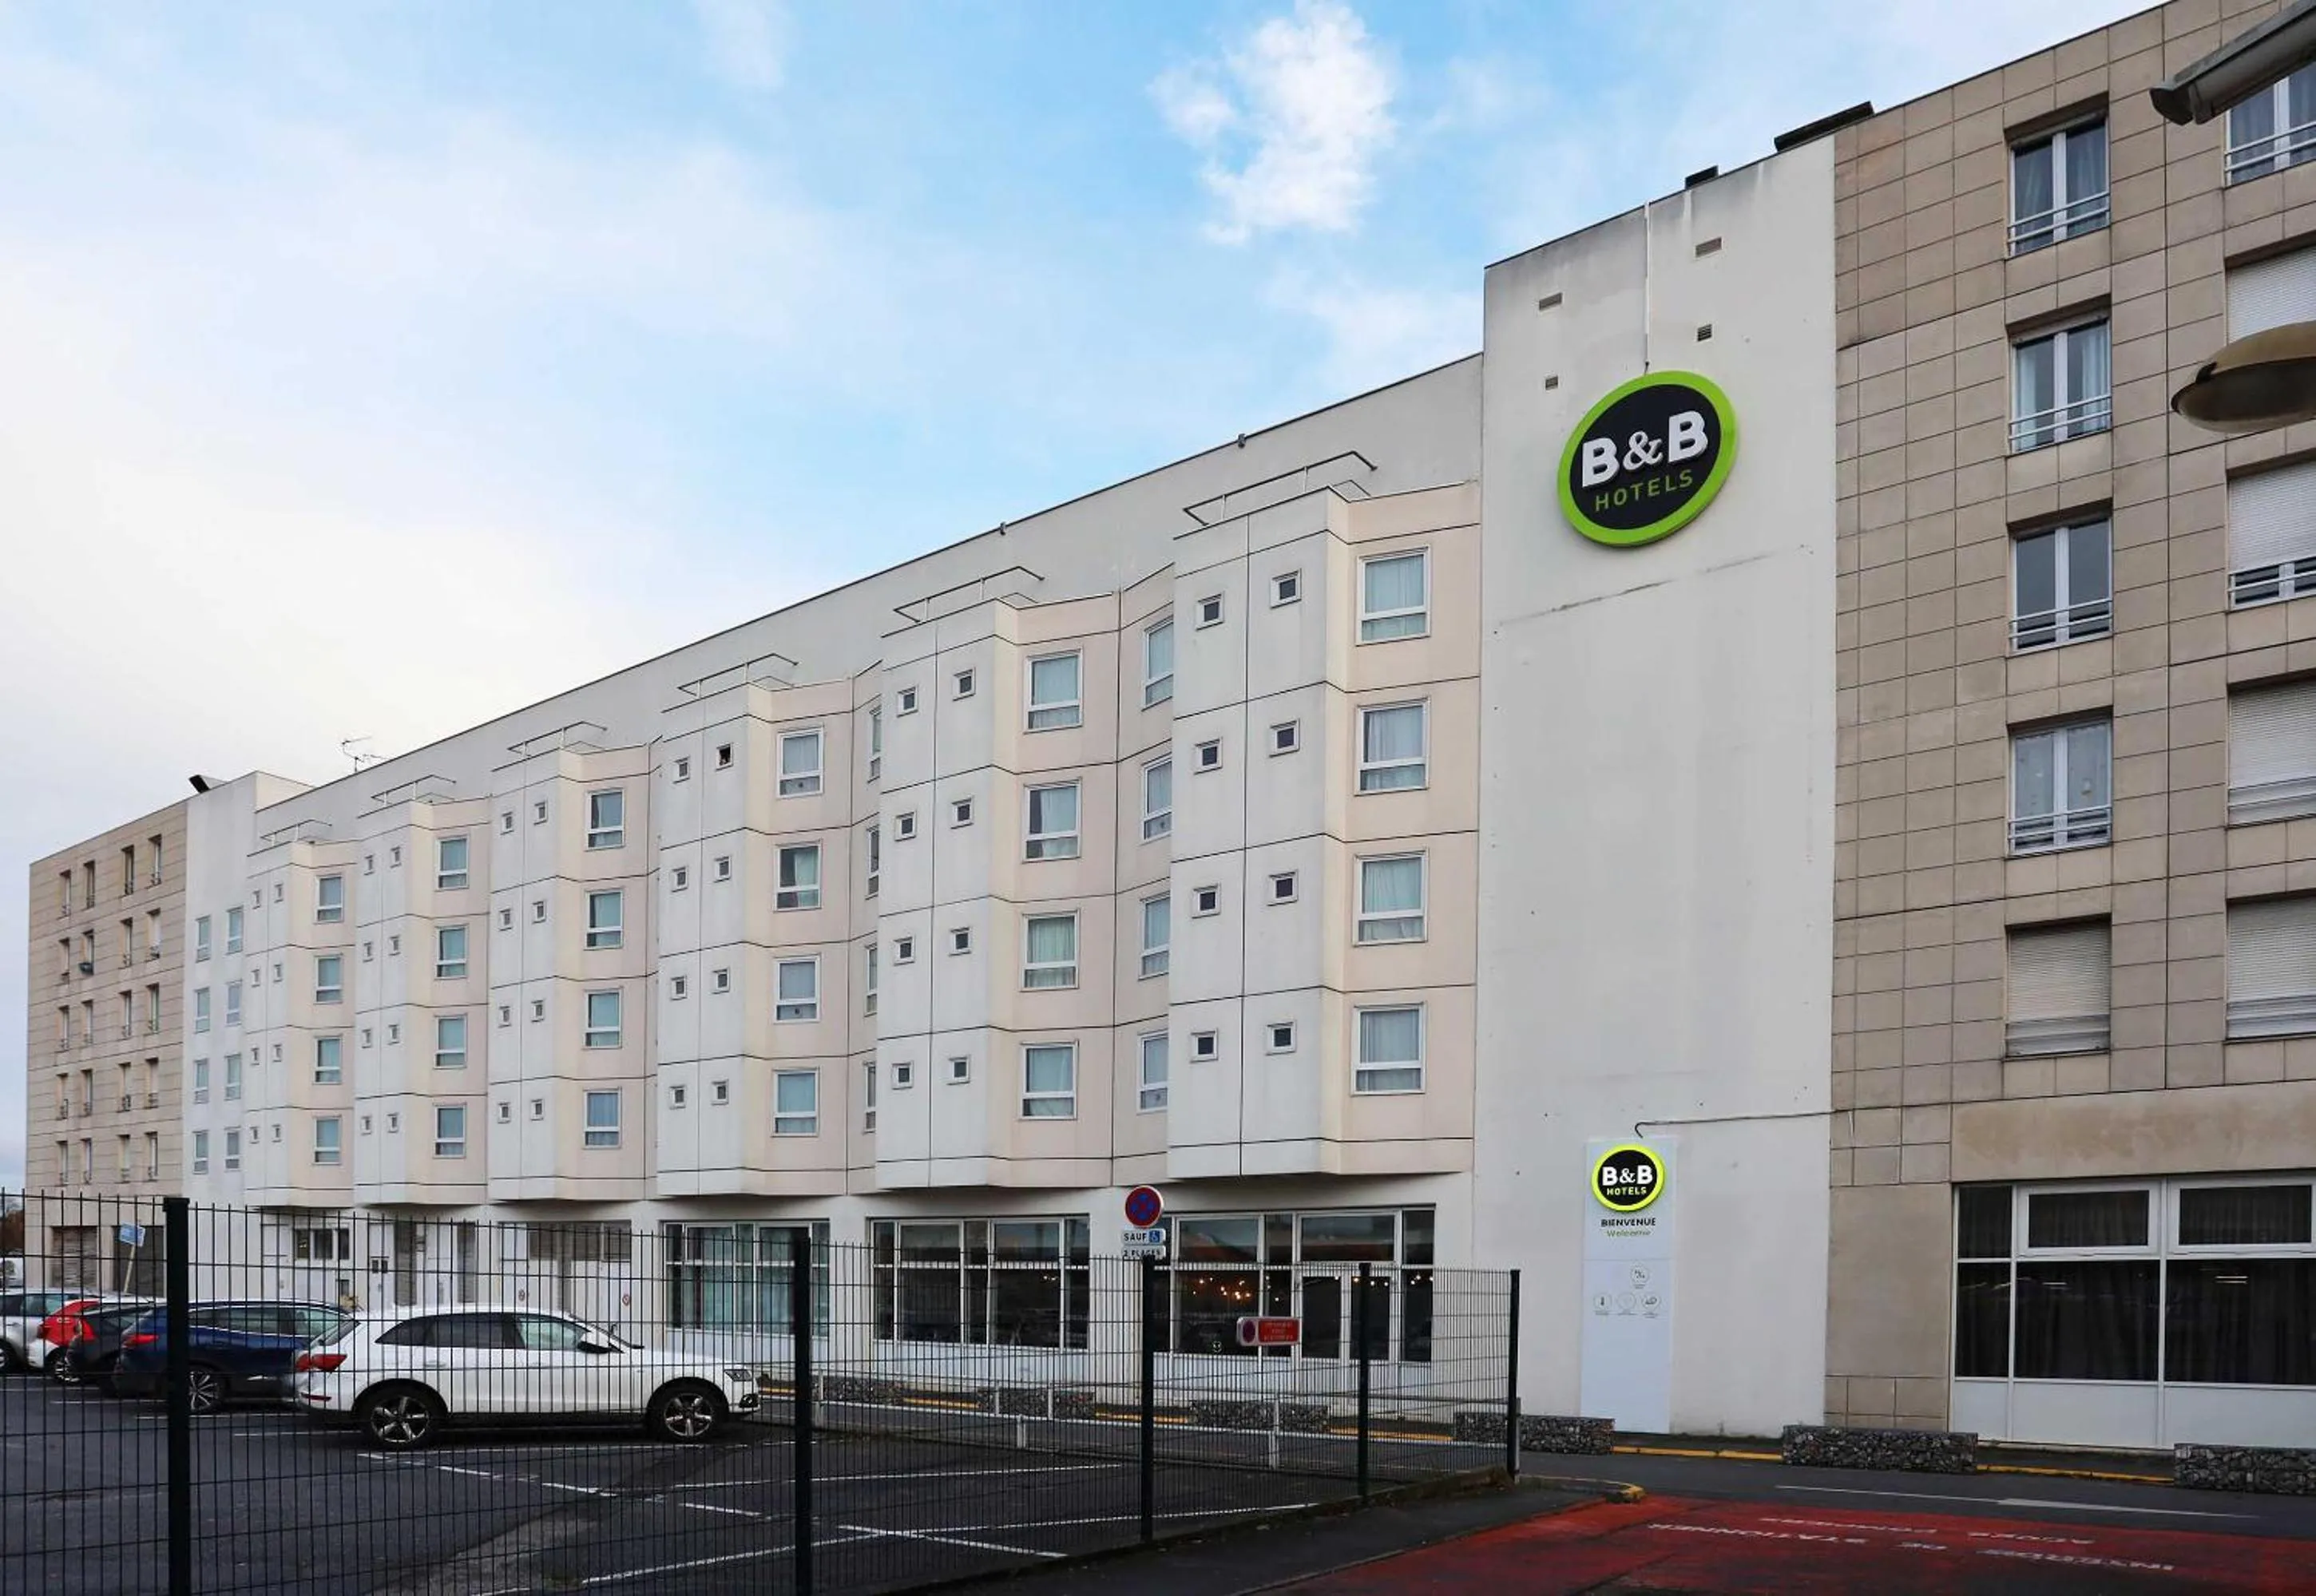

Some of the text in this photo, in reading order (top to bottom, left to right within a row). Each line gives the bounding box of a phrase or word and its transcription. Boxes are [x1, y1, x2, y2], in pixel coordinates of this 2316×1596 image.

[1581, 410, 1708, 489] B&B
[1595, 469, 1694, 512] HOTELS
[1602, 1164, 1653, 1186] B&B
[1606, 1186, 1647, 1196] HOTELS
[1600, 1218, 1656, 1227] BIENVENUE
[1124, 1233, 1147, 1242] SAUF
